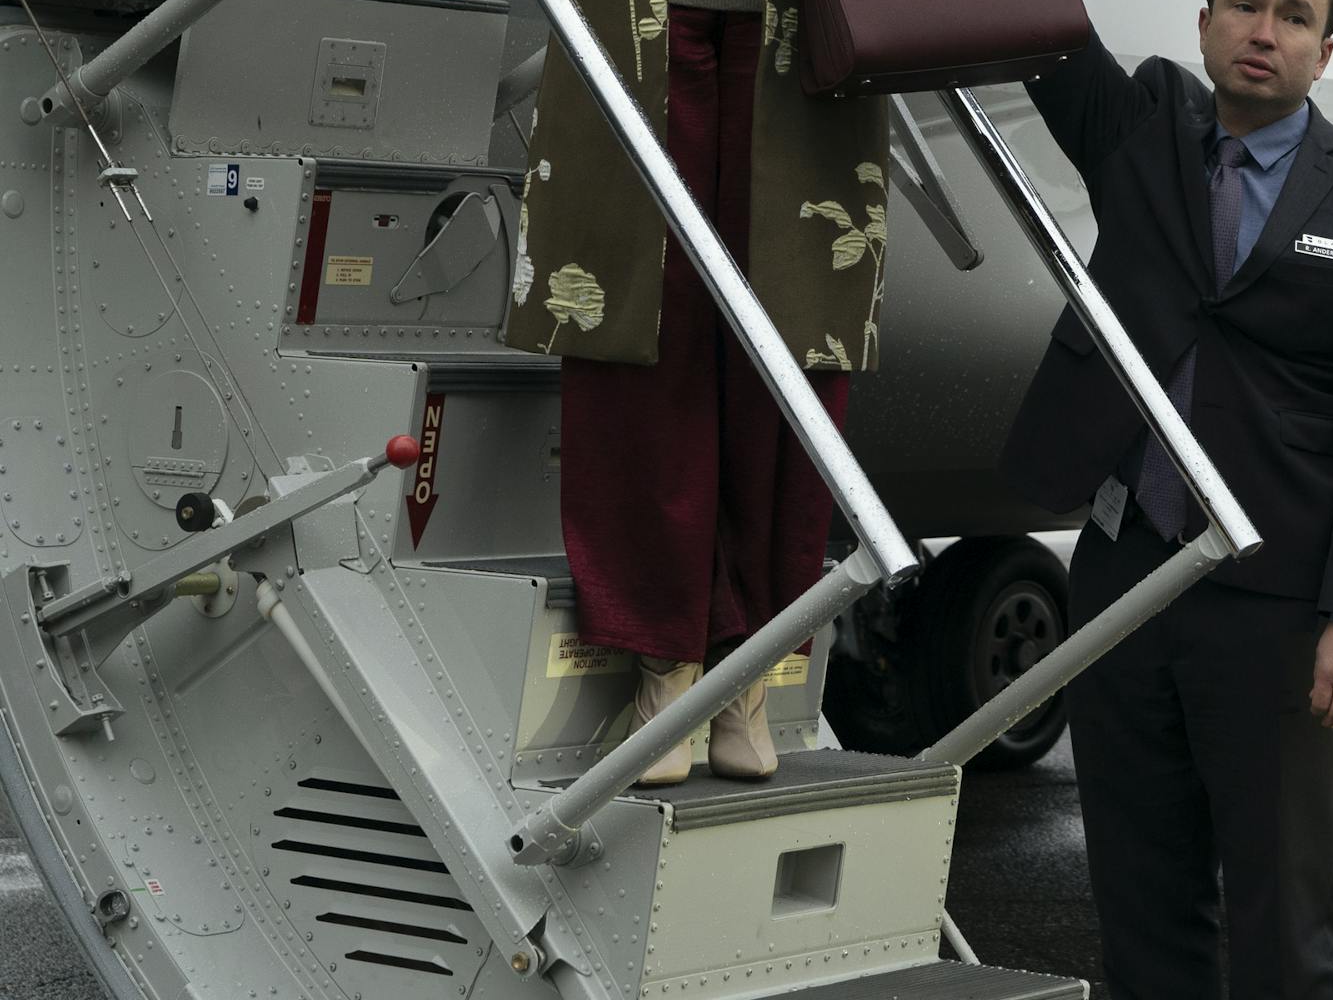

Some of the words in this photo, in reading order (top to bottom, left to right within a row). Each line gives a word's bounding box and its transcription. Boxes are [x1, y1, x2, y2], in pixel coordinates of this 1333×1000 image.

[227, 169, 238, 189] 9
[415, 405, 441, 504] OPEN
[559, 648, 595, 659] OPERATE
[574, 658, 607, 669] CAUTION
